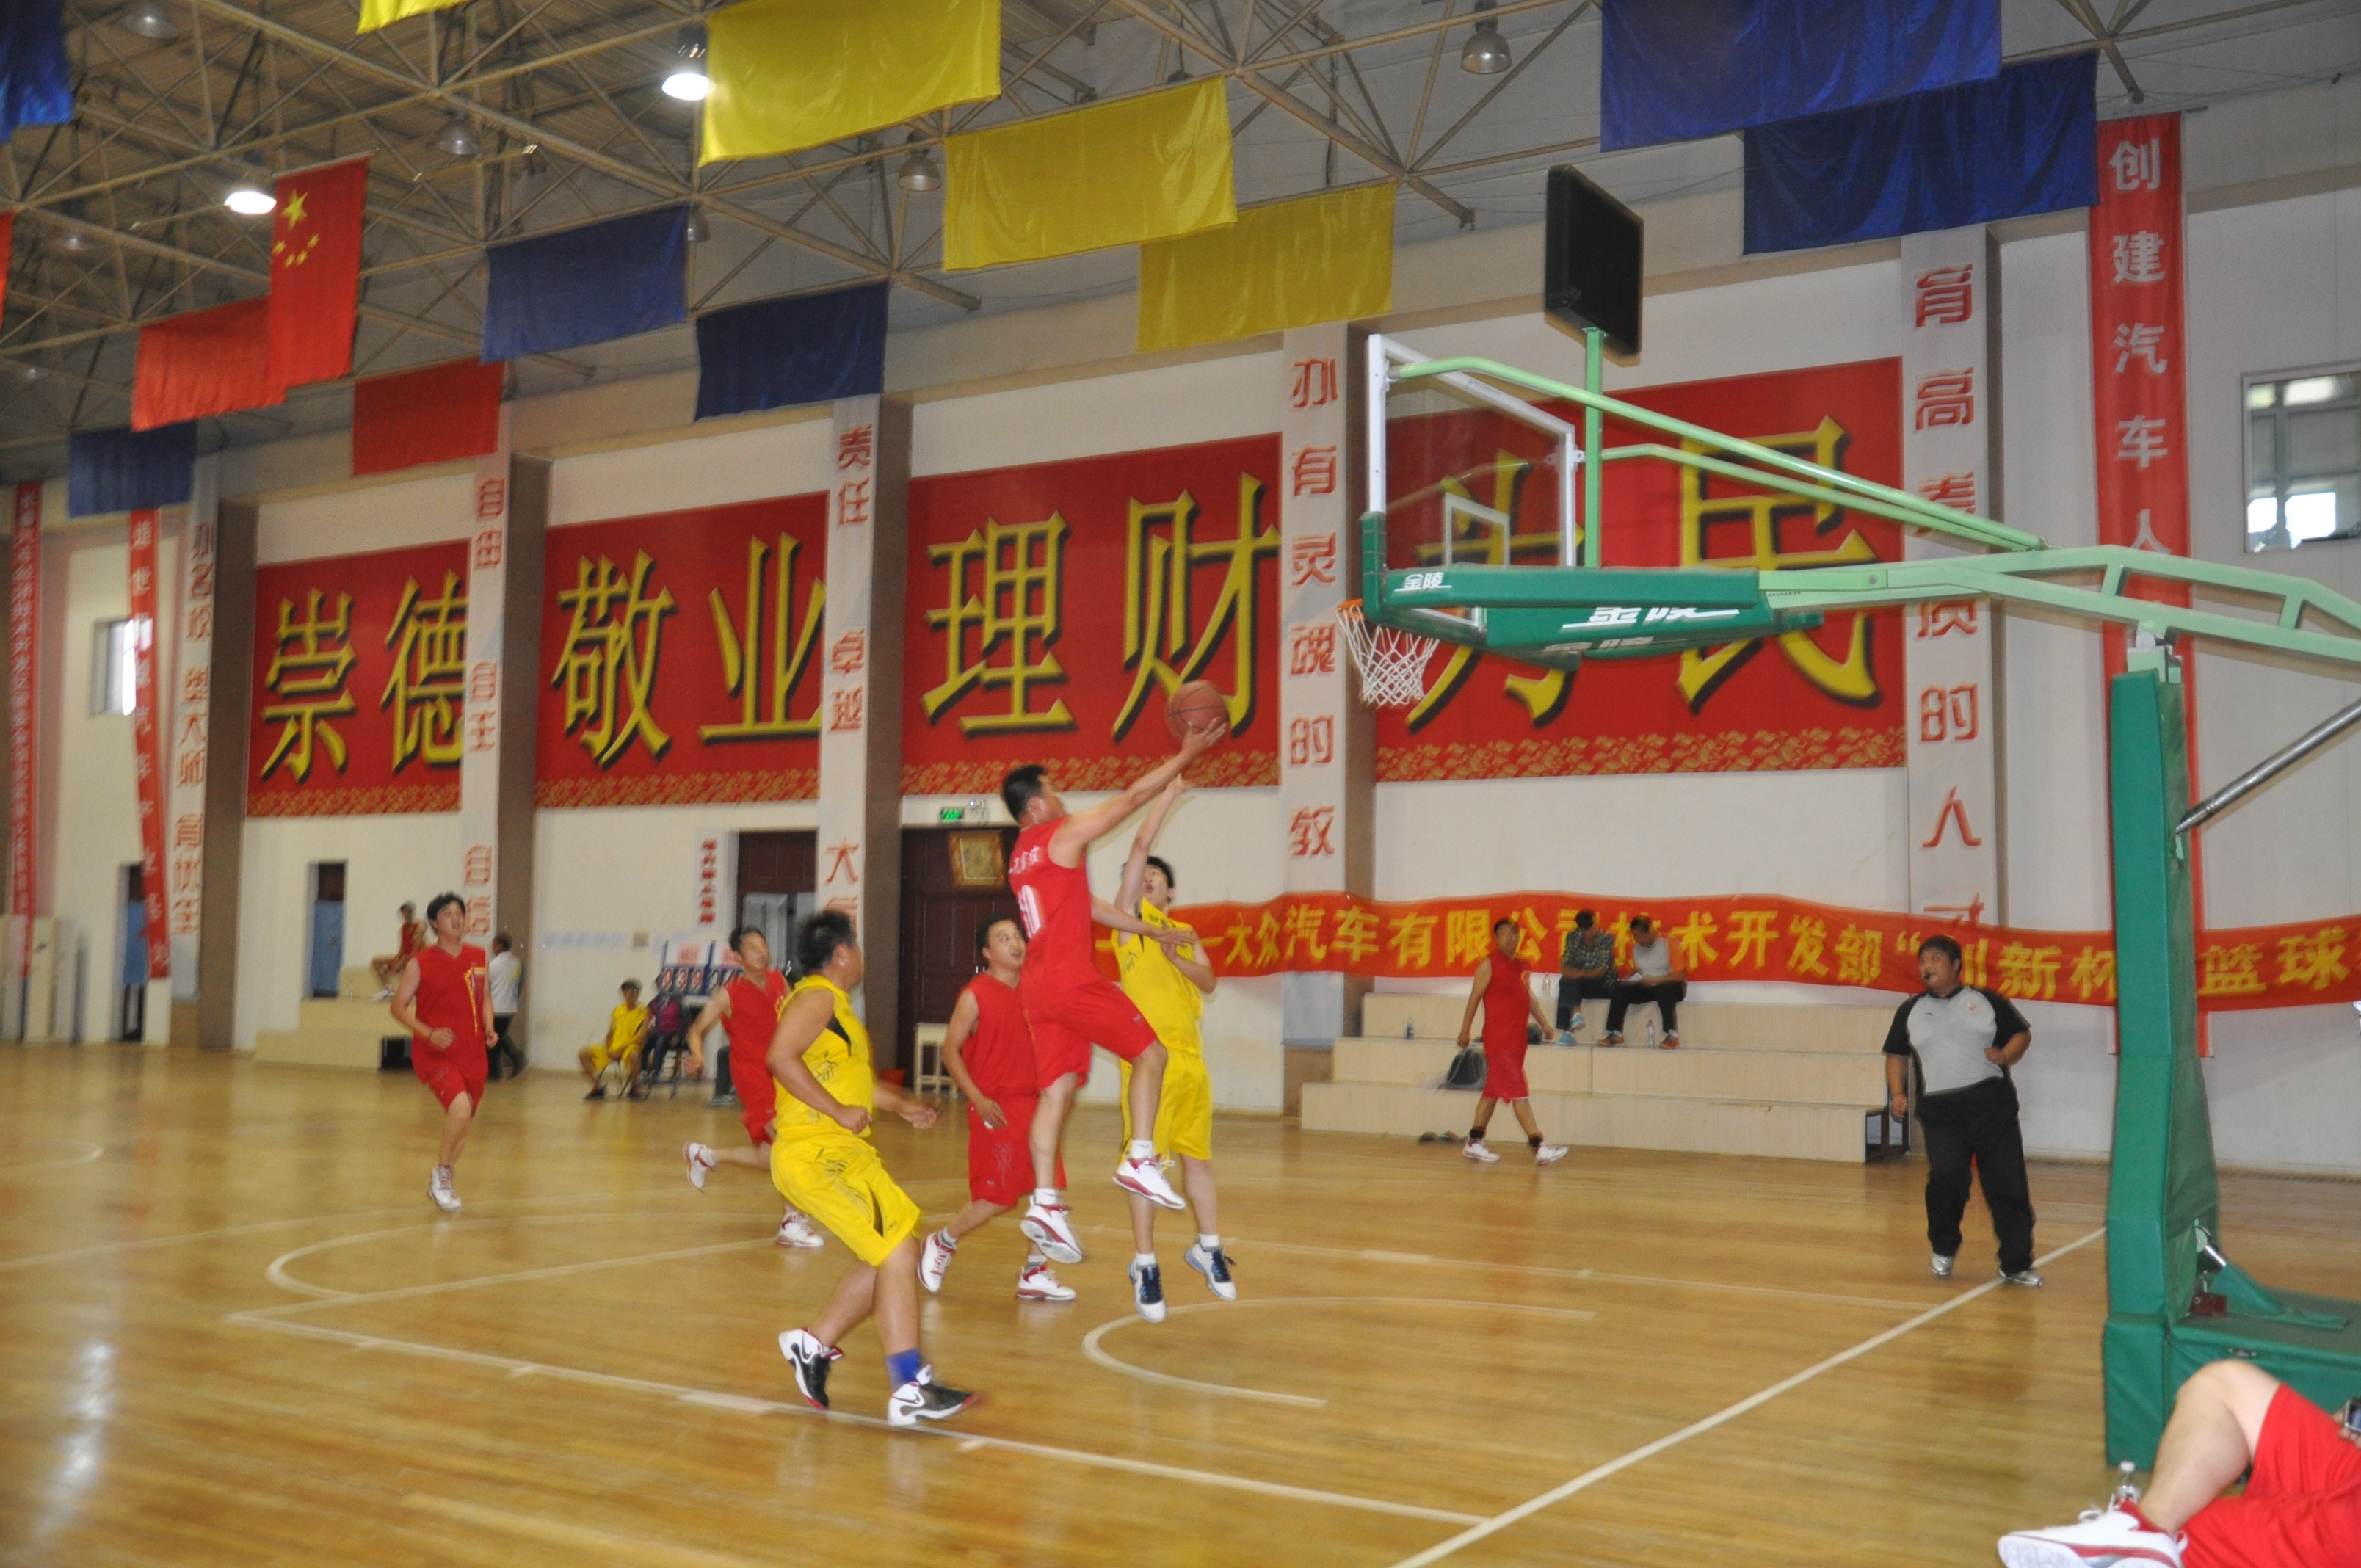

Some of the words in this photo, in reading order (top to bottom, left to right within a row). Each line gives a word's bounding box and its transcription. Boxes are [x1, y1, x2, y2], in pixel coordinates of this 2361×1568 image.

[475, 479, 505, 570] 自由
[837, 423, 872, 527] 责任
[922, 471, 1280, 740] 理财
[1291, 357, 1338, 857] 办有灵魂的教
[1403, 572, 1445, 590] 金陵
[261, 570, 467, 781] 崇德
[551, 532, 826, 767] 敬业
[831, 628, 866, 732] 卓越
[468, 660, 498, 754] 自主
[463, 844, 492, 935] 自信
